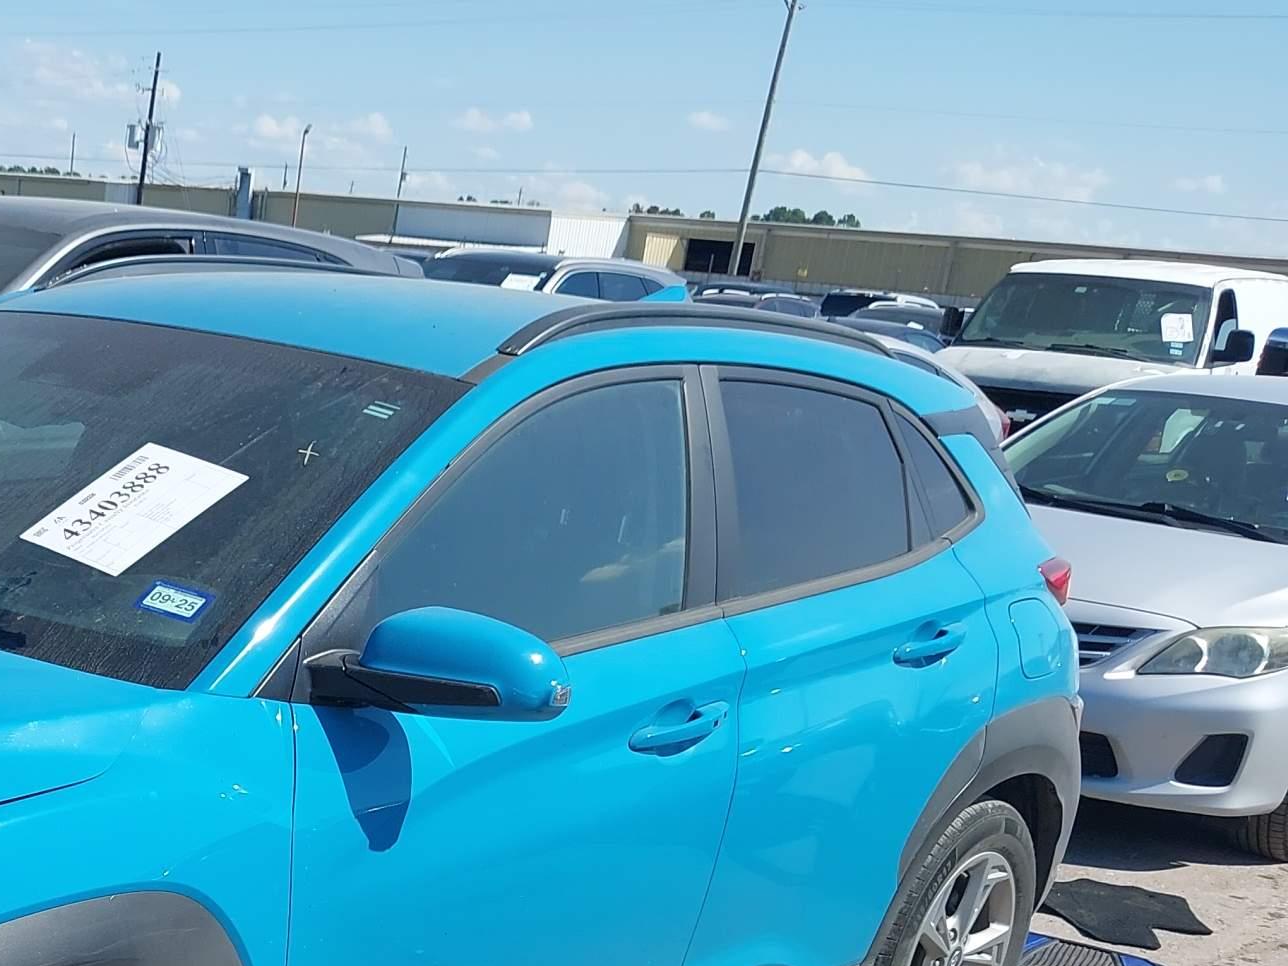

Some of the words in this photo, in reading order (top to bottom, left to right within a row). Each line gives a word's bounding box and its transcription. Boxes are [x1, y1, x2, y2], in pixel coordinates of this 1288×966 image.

[62, 462, 170, 541] 43403888
[149, 591, 172, 604] 09
[174, 598, 199, 612] 25
